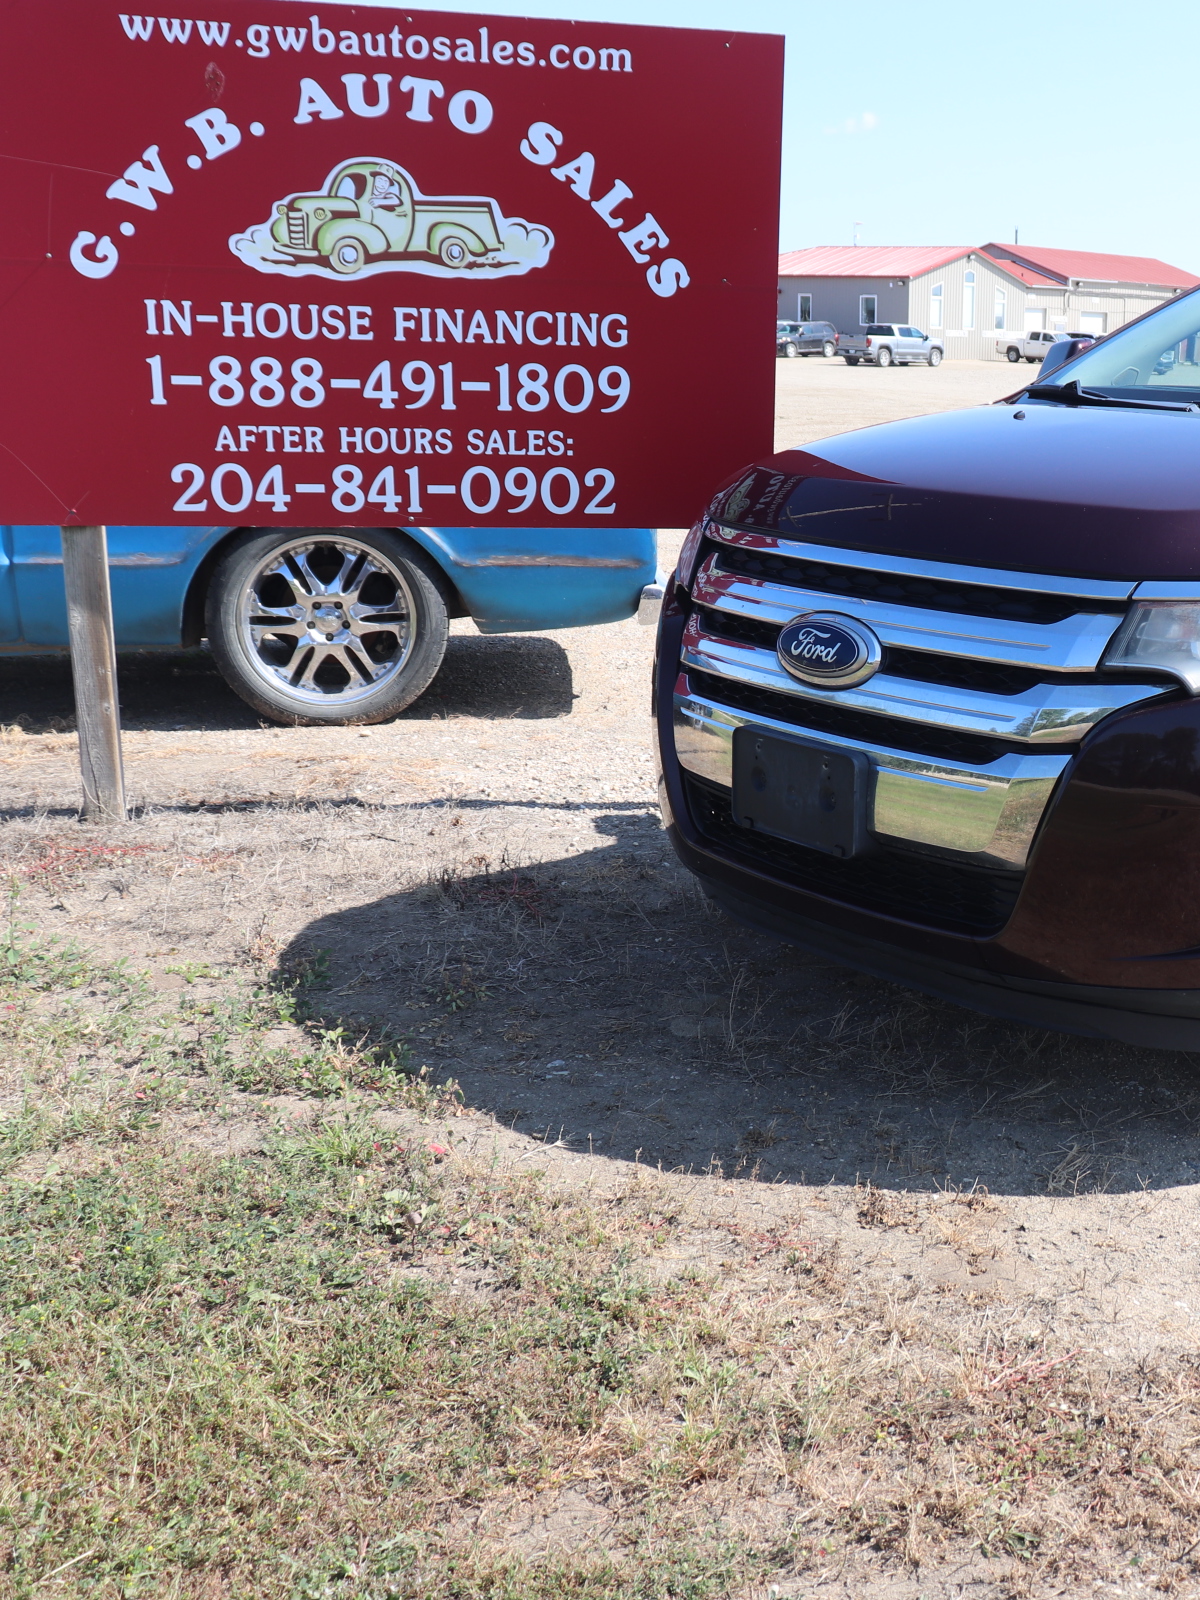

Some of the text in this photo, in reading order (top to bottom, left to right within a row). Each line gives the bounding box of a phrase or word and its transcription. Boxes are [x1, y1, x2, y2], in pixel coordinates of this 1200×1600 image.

[119, 13, 634, 73] www.gwbautosales.com
[70, 73, 691, 298] G.W.B. AUTO SALES
[144, 299, 628, 348] IN-HOUSE FINANCING
[146, 355, 631, 414] 1-888-491-1809
[215, 425, 574, 456] AFTER HOURS SALES:
[171, 463, 617, 515] 204-841-0902
[791, 628, 841, 663] Ford
